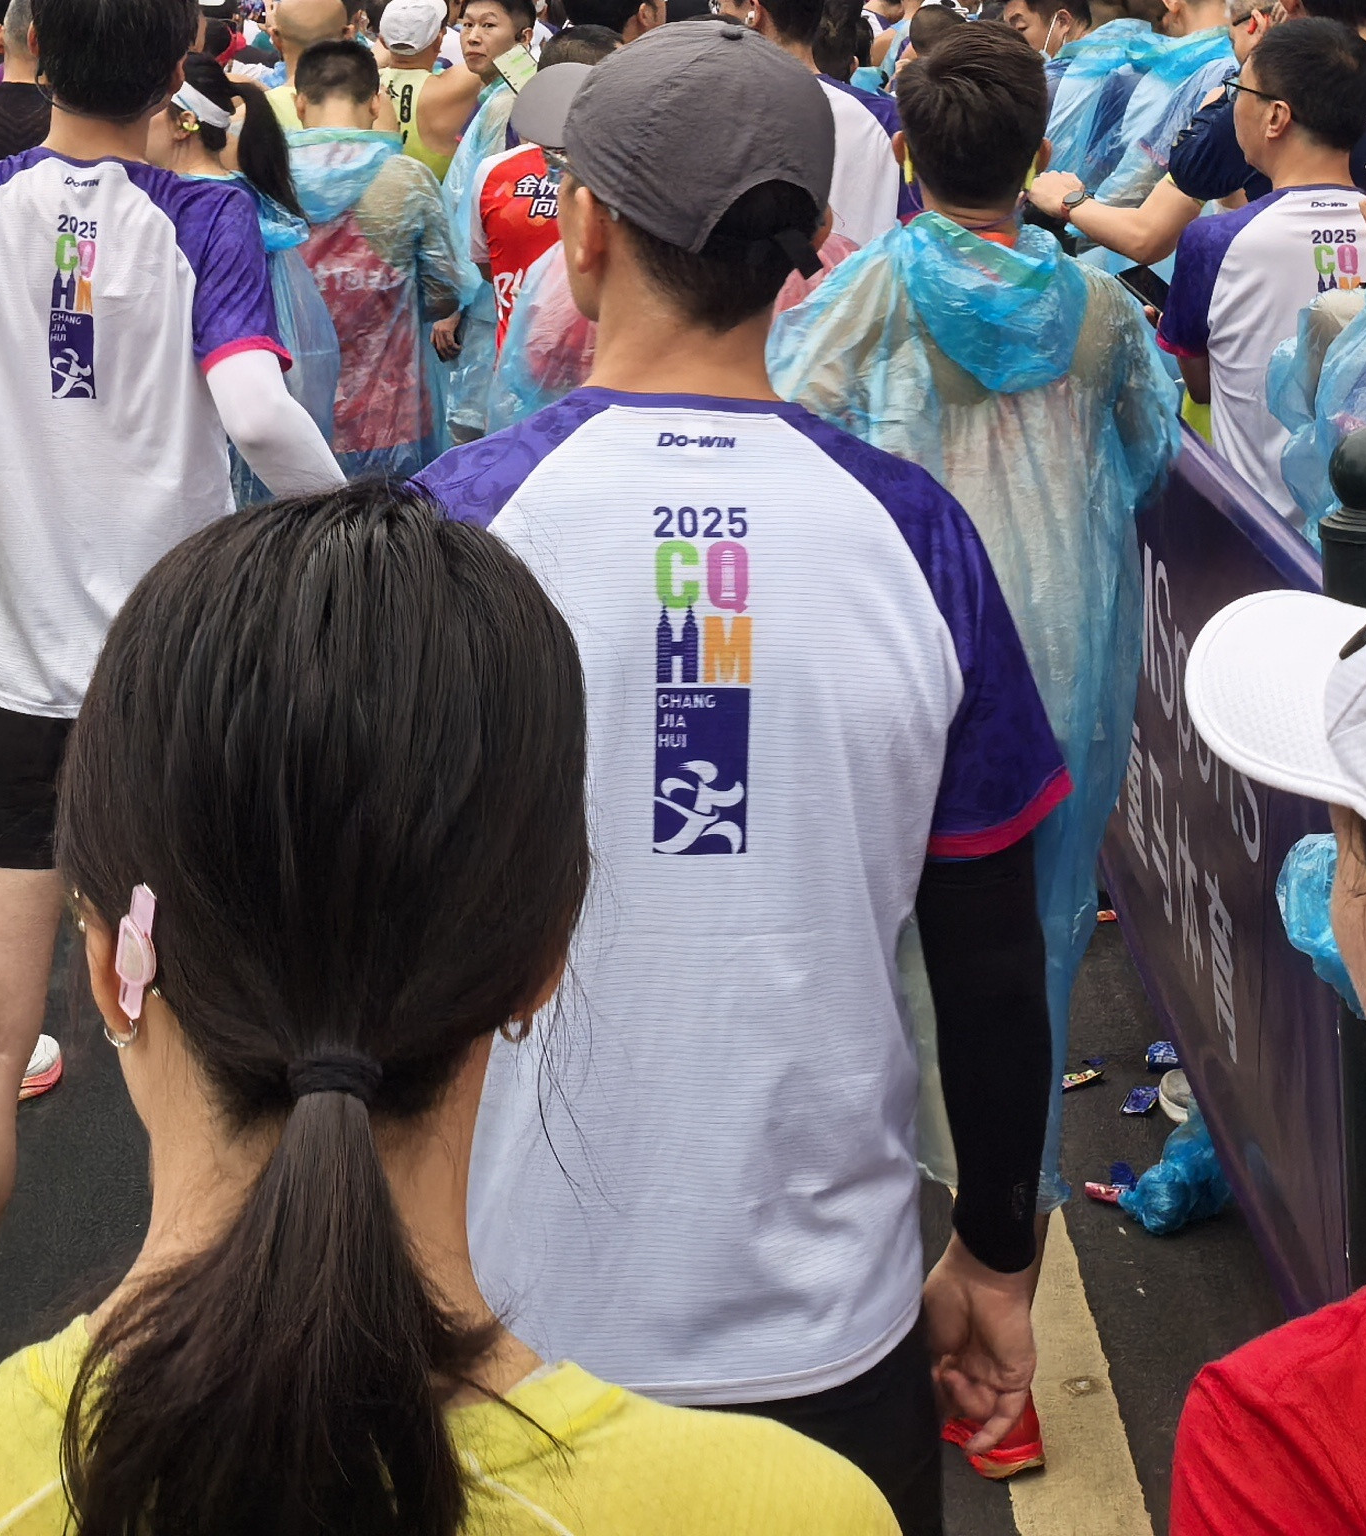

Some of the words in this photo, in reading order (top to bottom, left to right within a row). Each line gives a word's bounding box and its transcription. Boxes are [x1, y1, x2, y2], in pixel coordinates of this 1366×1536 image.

[57, 214, 98, 240] 2025
[1311, 229, 1357, 244] 2025
[1313, 244, 1359, 276] CQ
[51, 313, 82, 326] CHANG
[653, 506, 749, 539] 2025
[655, 540, 750, 614] CQ
[655, 604, 753, 684] HM
[657, 694, 717, 709] CHANG
[658, 714, 687, 728] JIA
[658, 734, 688, 748] HUI
